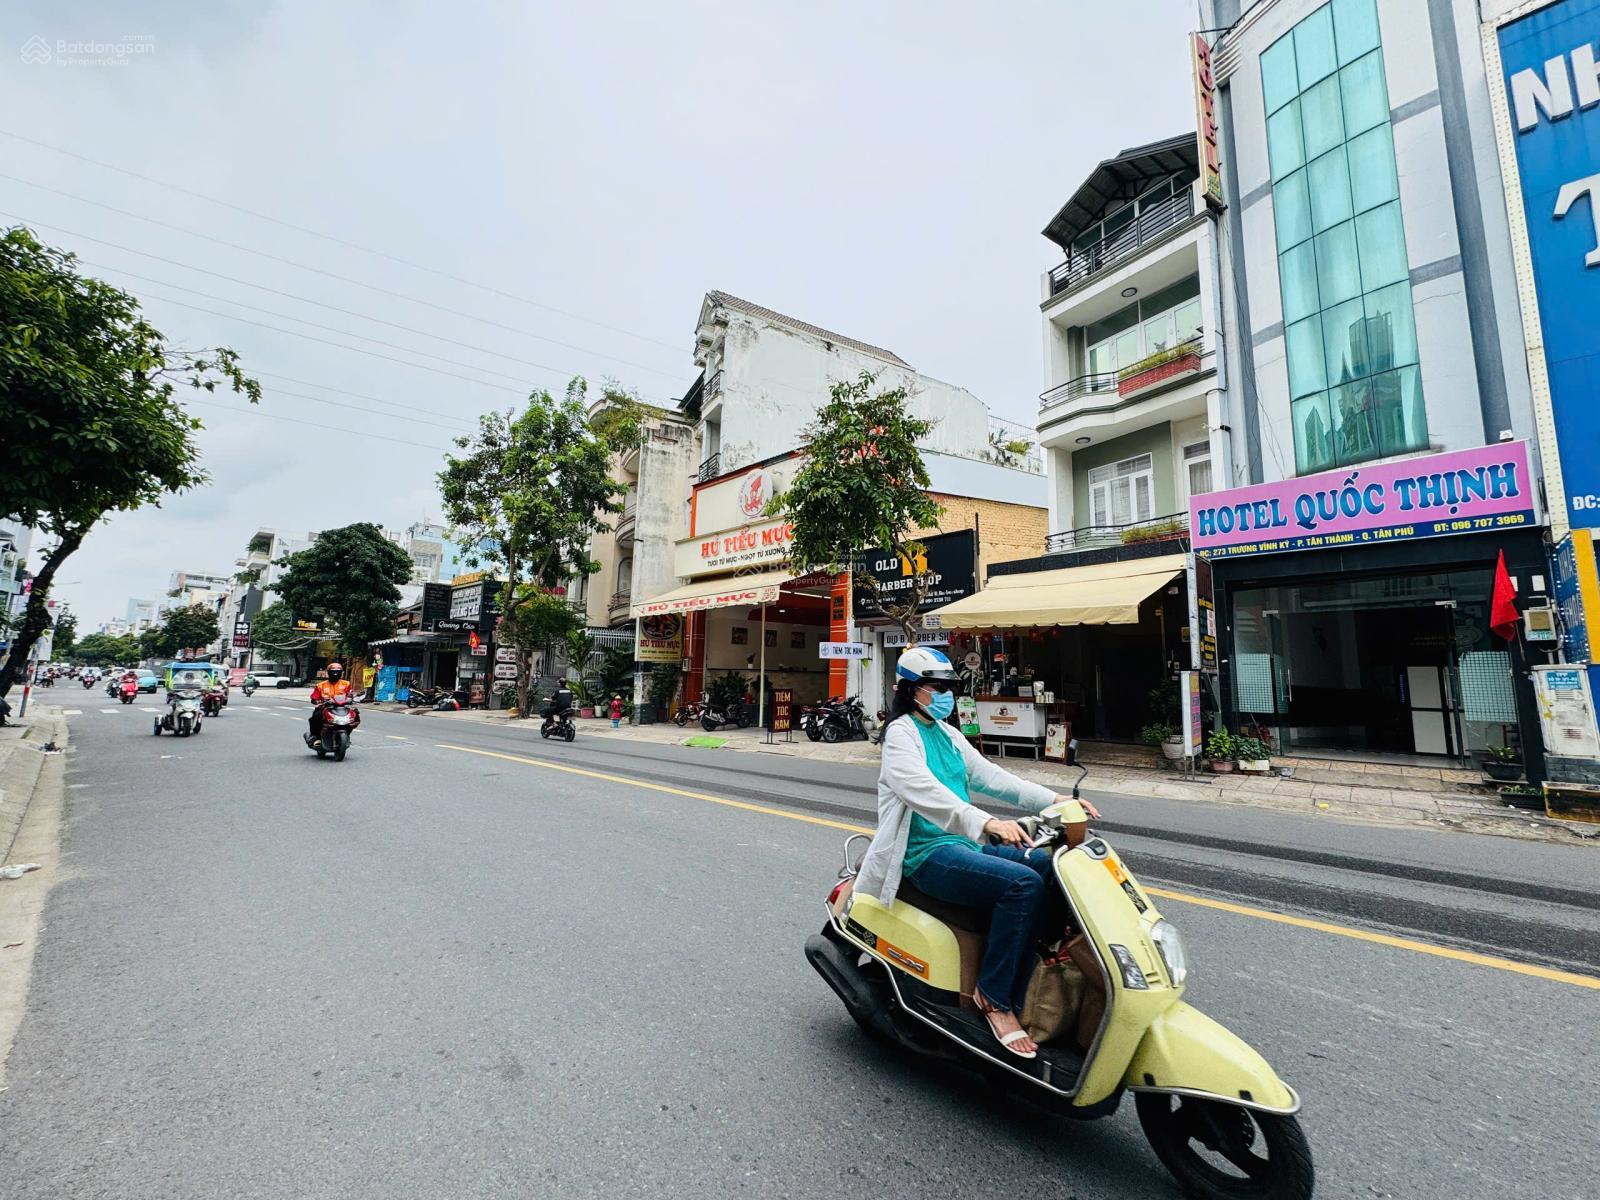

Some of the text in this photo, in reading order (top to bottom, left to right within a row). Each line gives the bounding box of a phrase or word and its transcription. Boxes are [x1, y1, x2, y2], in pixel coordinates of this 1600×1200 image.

[1198, 462, 1520, 537] HOTEL QUỐC THỊNH
[1433, 514, 1524, 533] ĐT: 096 707 3969
[1213, 548, 1226, 556] 273
[1306, 536, 1322, 546] TÂN
[1325, 533, 1354, 544] THÀNH
[1362, 532, 1371, 540] Q.
[1373, 528, 1392, 539] TÂN
[1394, 526, 1414, 536] PHÚ
[875, 558, 898, 572] OLD
[774, 720, 790, 730] NAM
